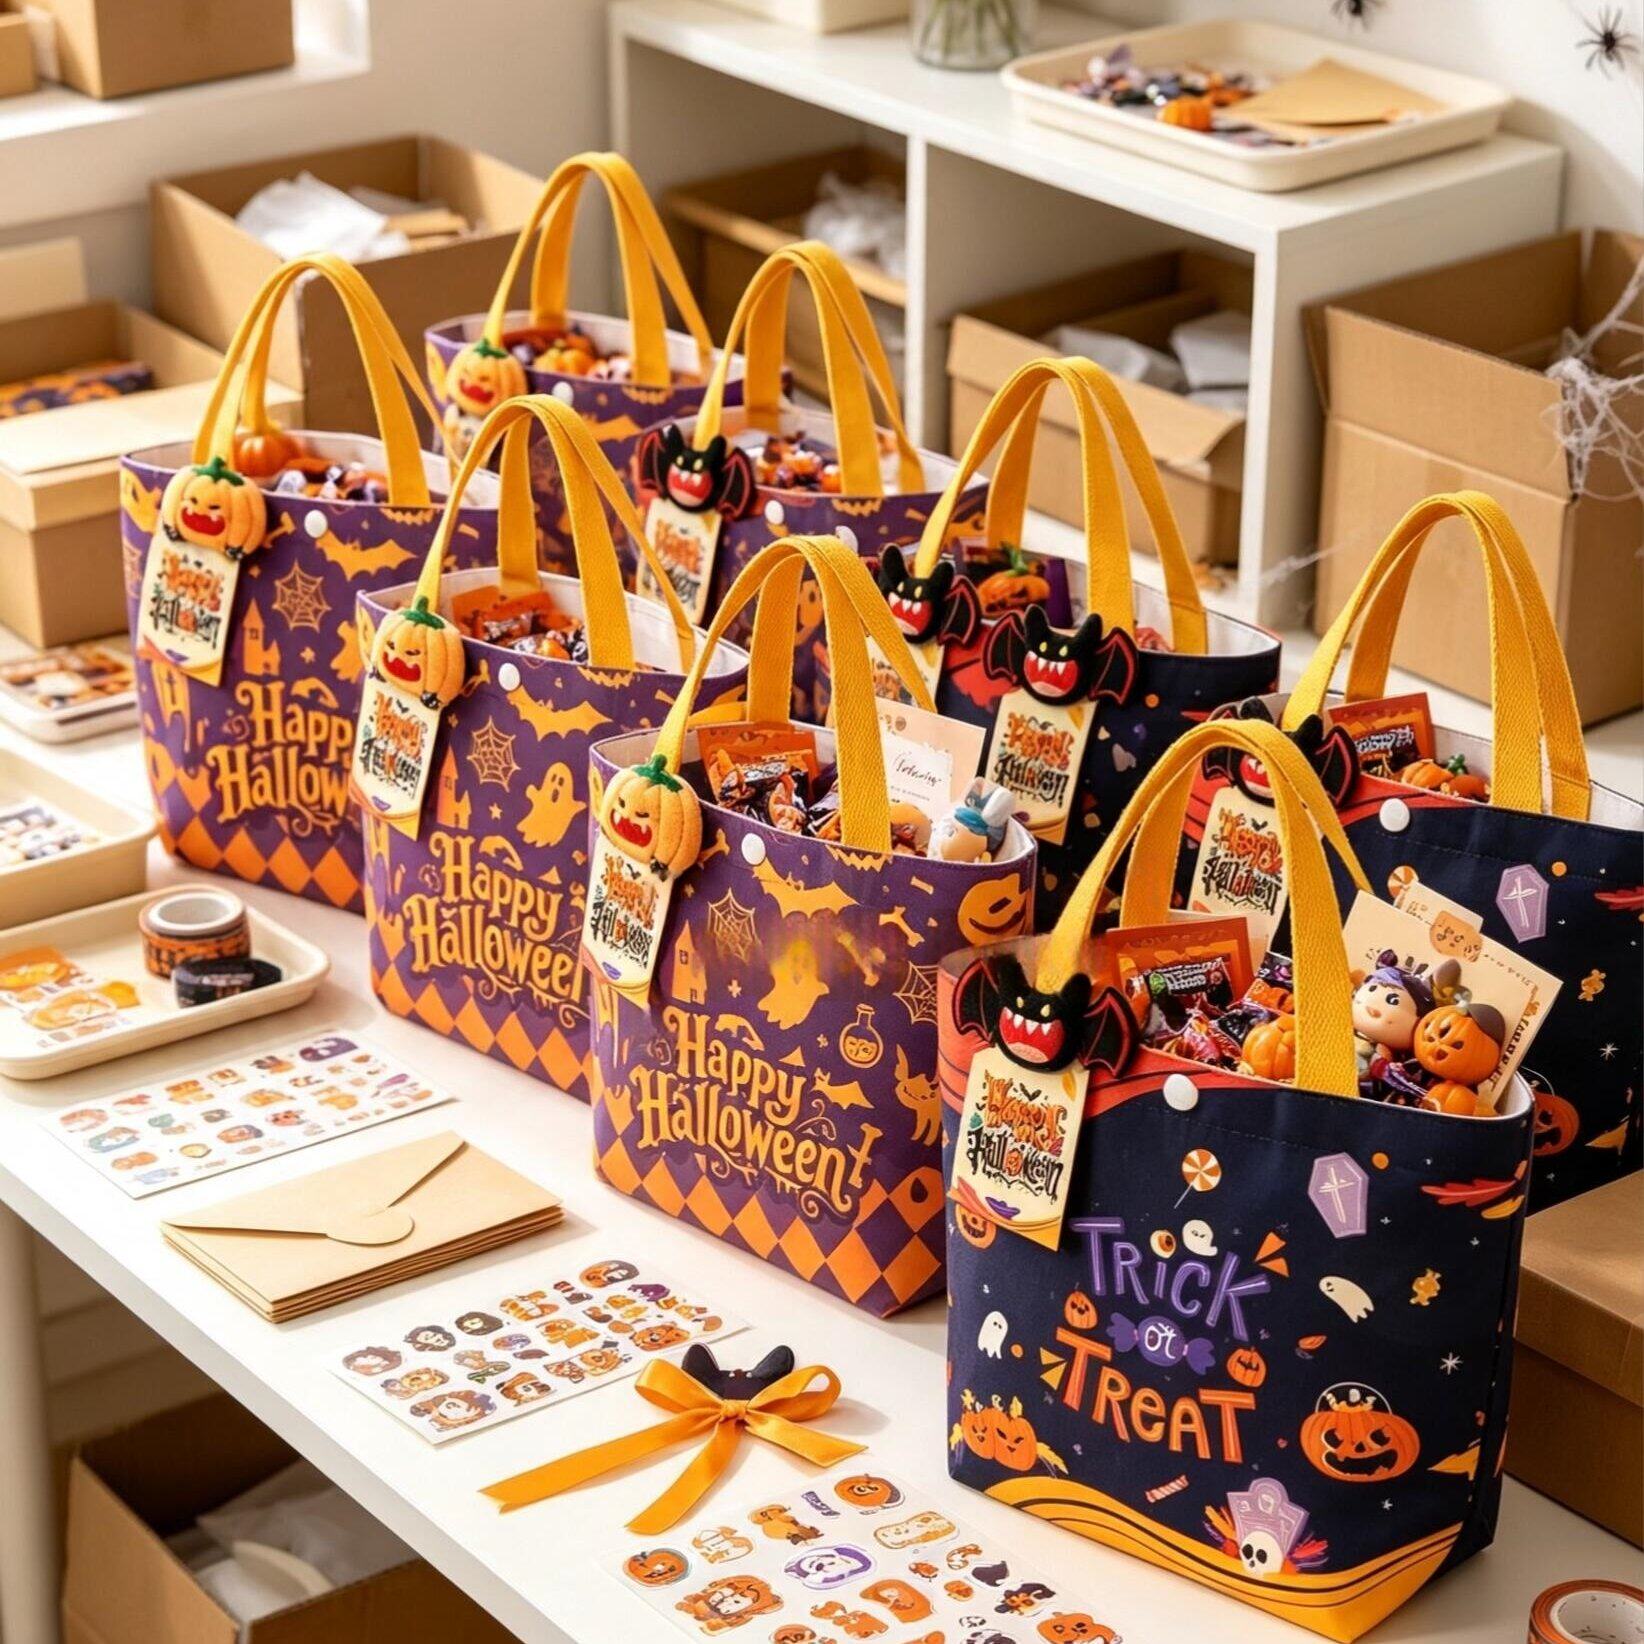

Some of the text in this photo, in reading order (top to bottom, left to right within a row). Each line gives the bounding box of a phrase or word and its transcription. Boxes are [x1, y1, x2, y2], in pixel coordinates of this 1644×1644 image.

[235, 680, 354, 768] Happ
[205, 743, 351, 824] Hallow
[429, 831, 563, 942] Happy
[662, 1005, 806, 1126] Happy
